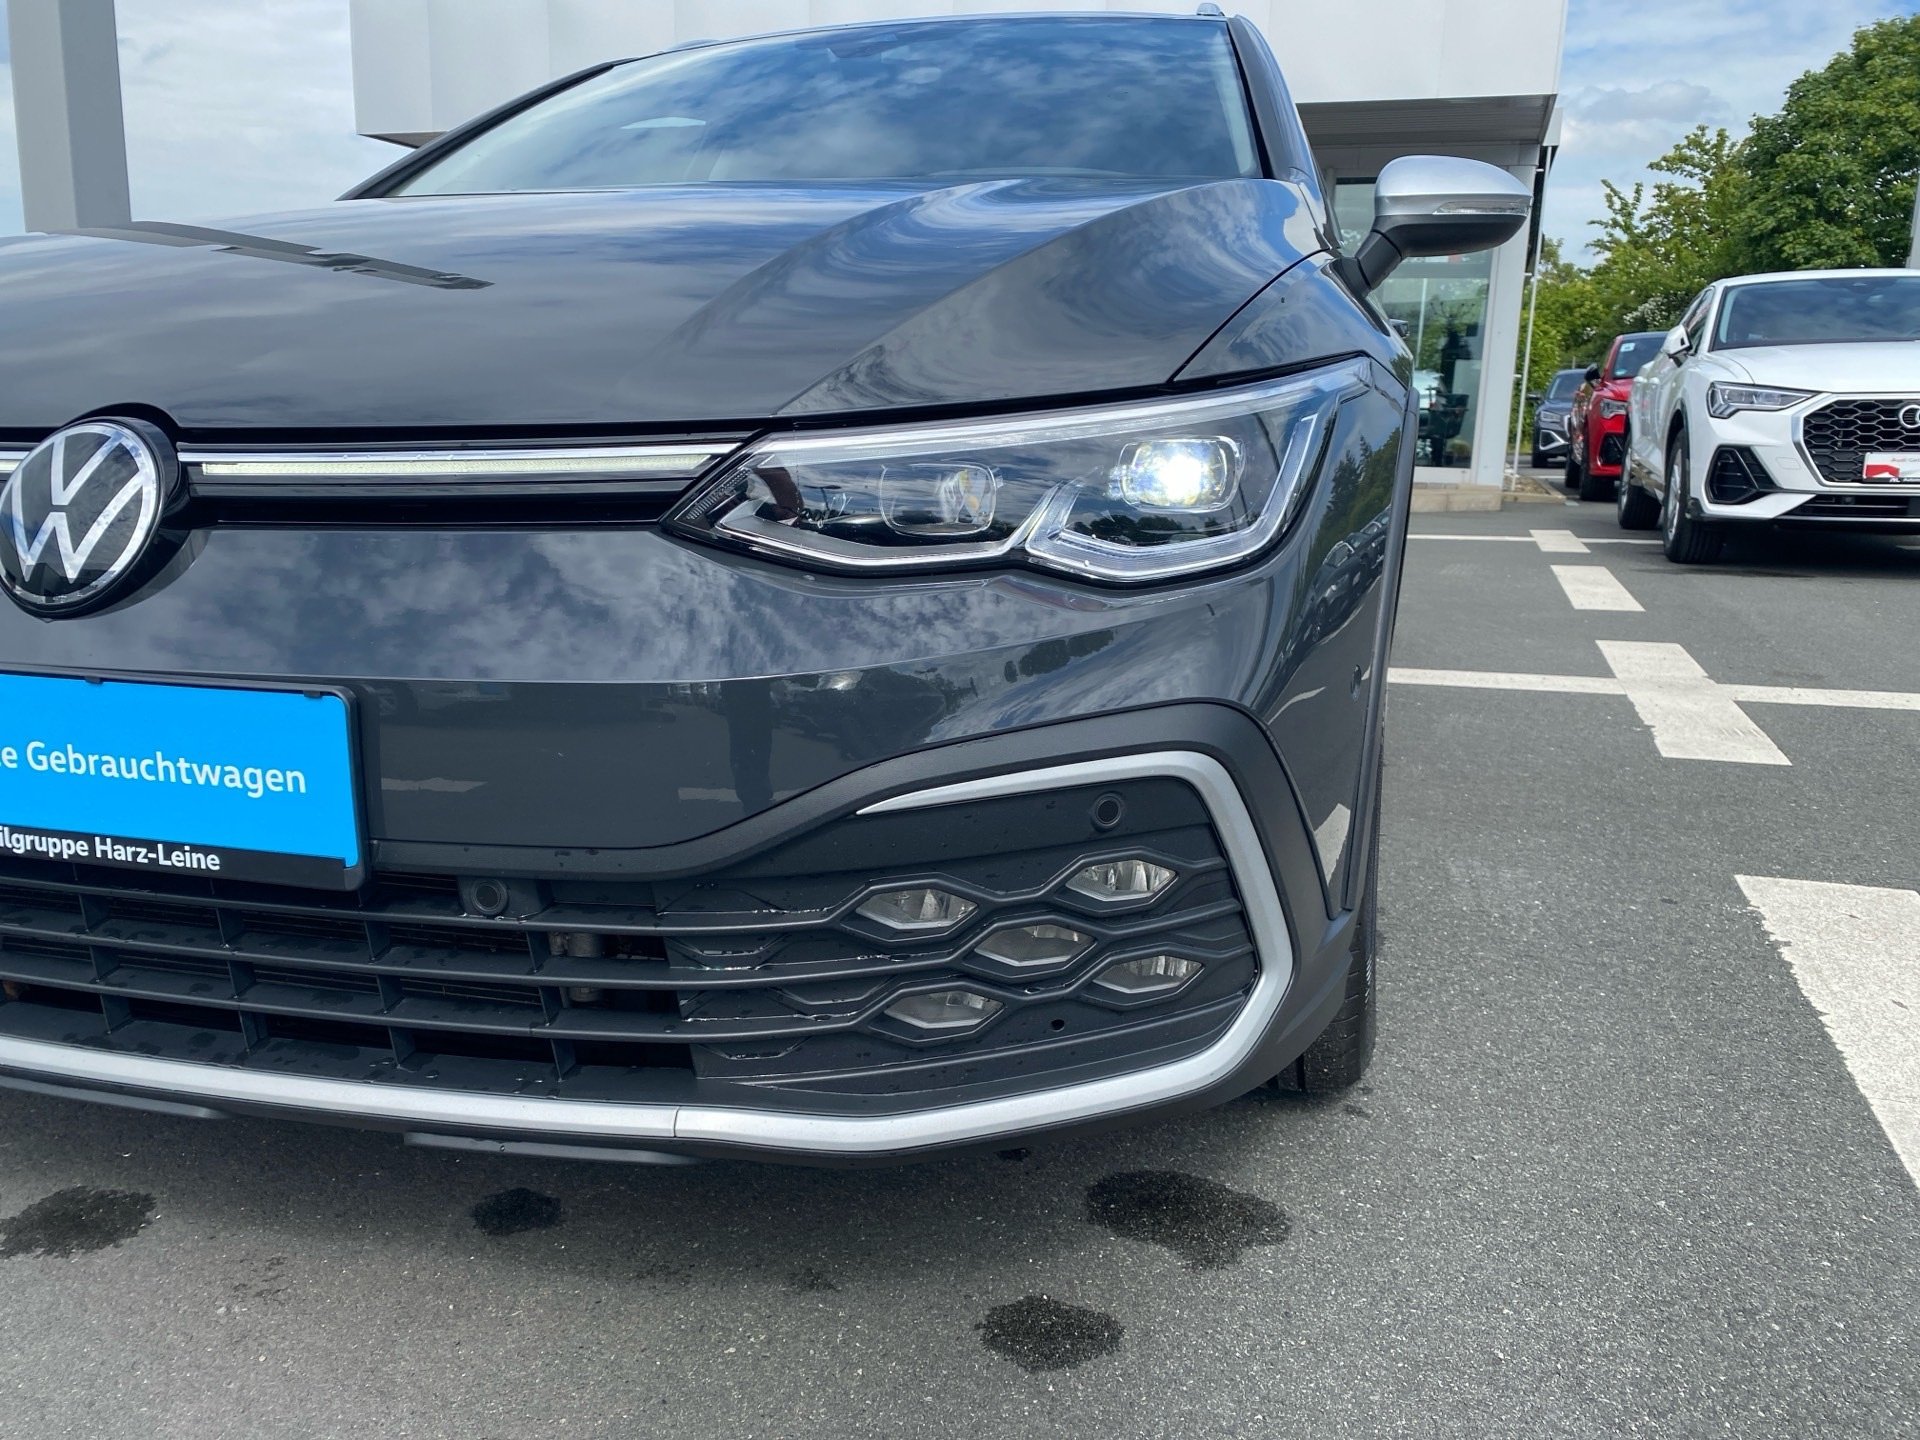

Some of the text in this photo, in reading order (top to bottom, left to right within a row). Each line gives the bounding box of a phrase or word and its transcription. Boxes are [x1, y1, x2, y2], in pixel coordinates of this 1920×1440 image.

[6, 429, 150, 586] VW
[0, 740, 307, 799] e Gebrauchtwagen
[0, 825, 222, 871] ilgruppe Harz-Leine
